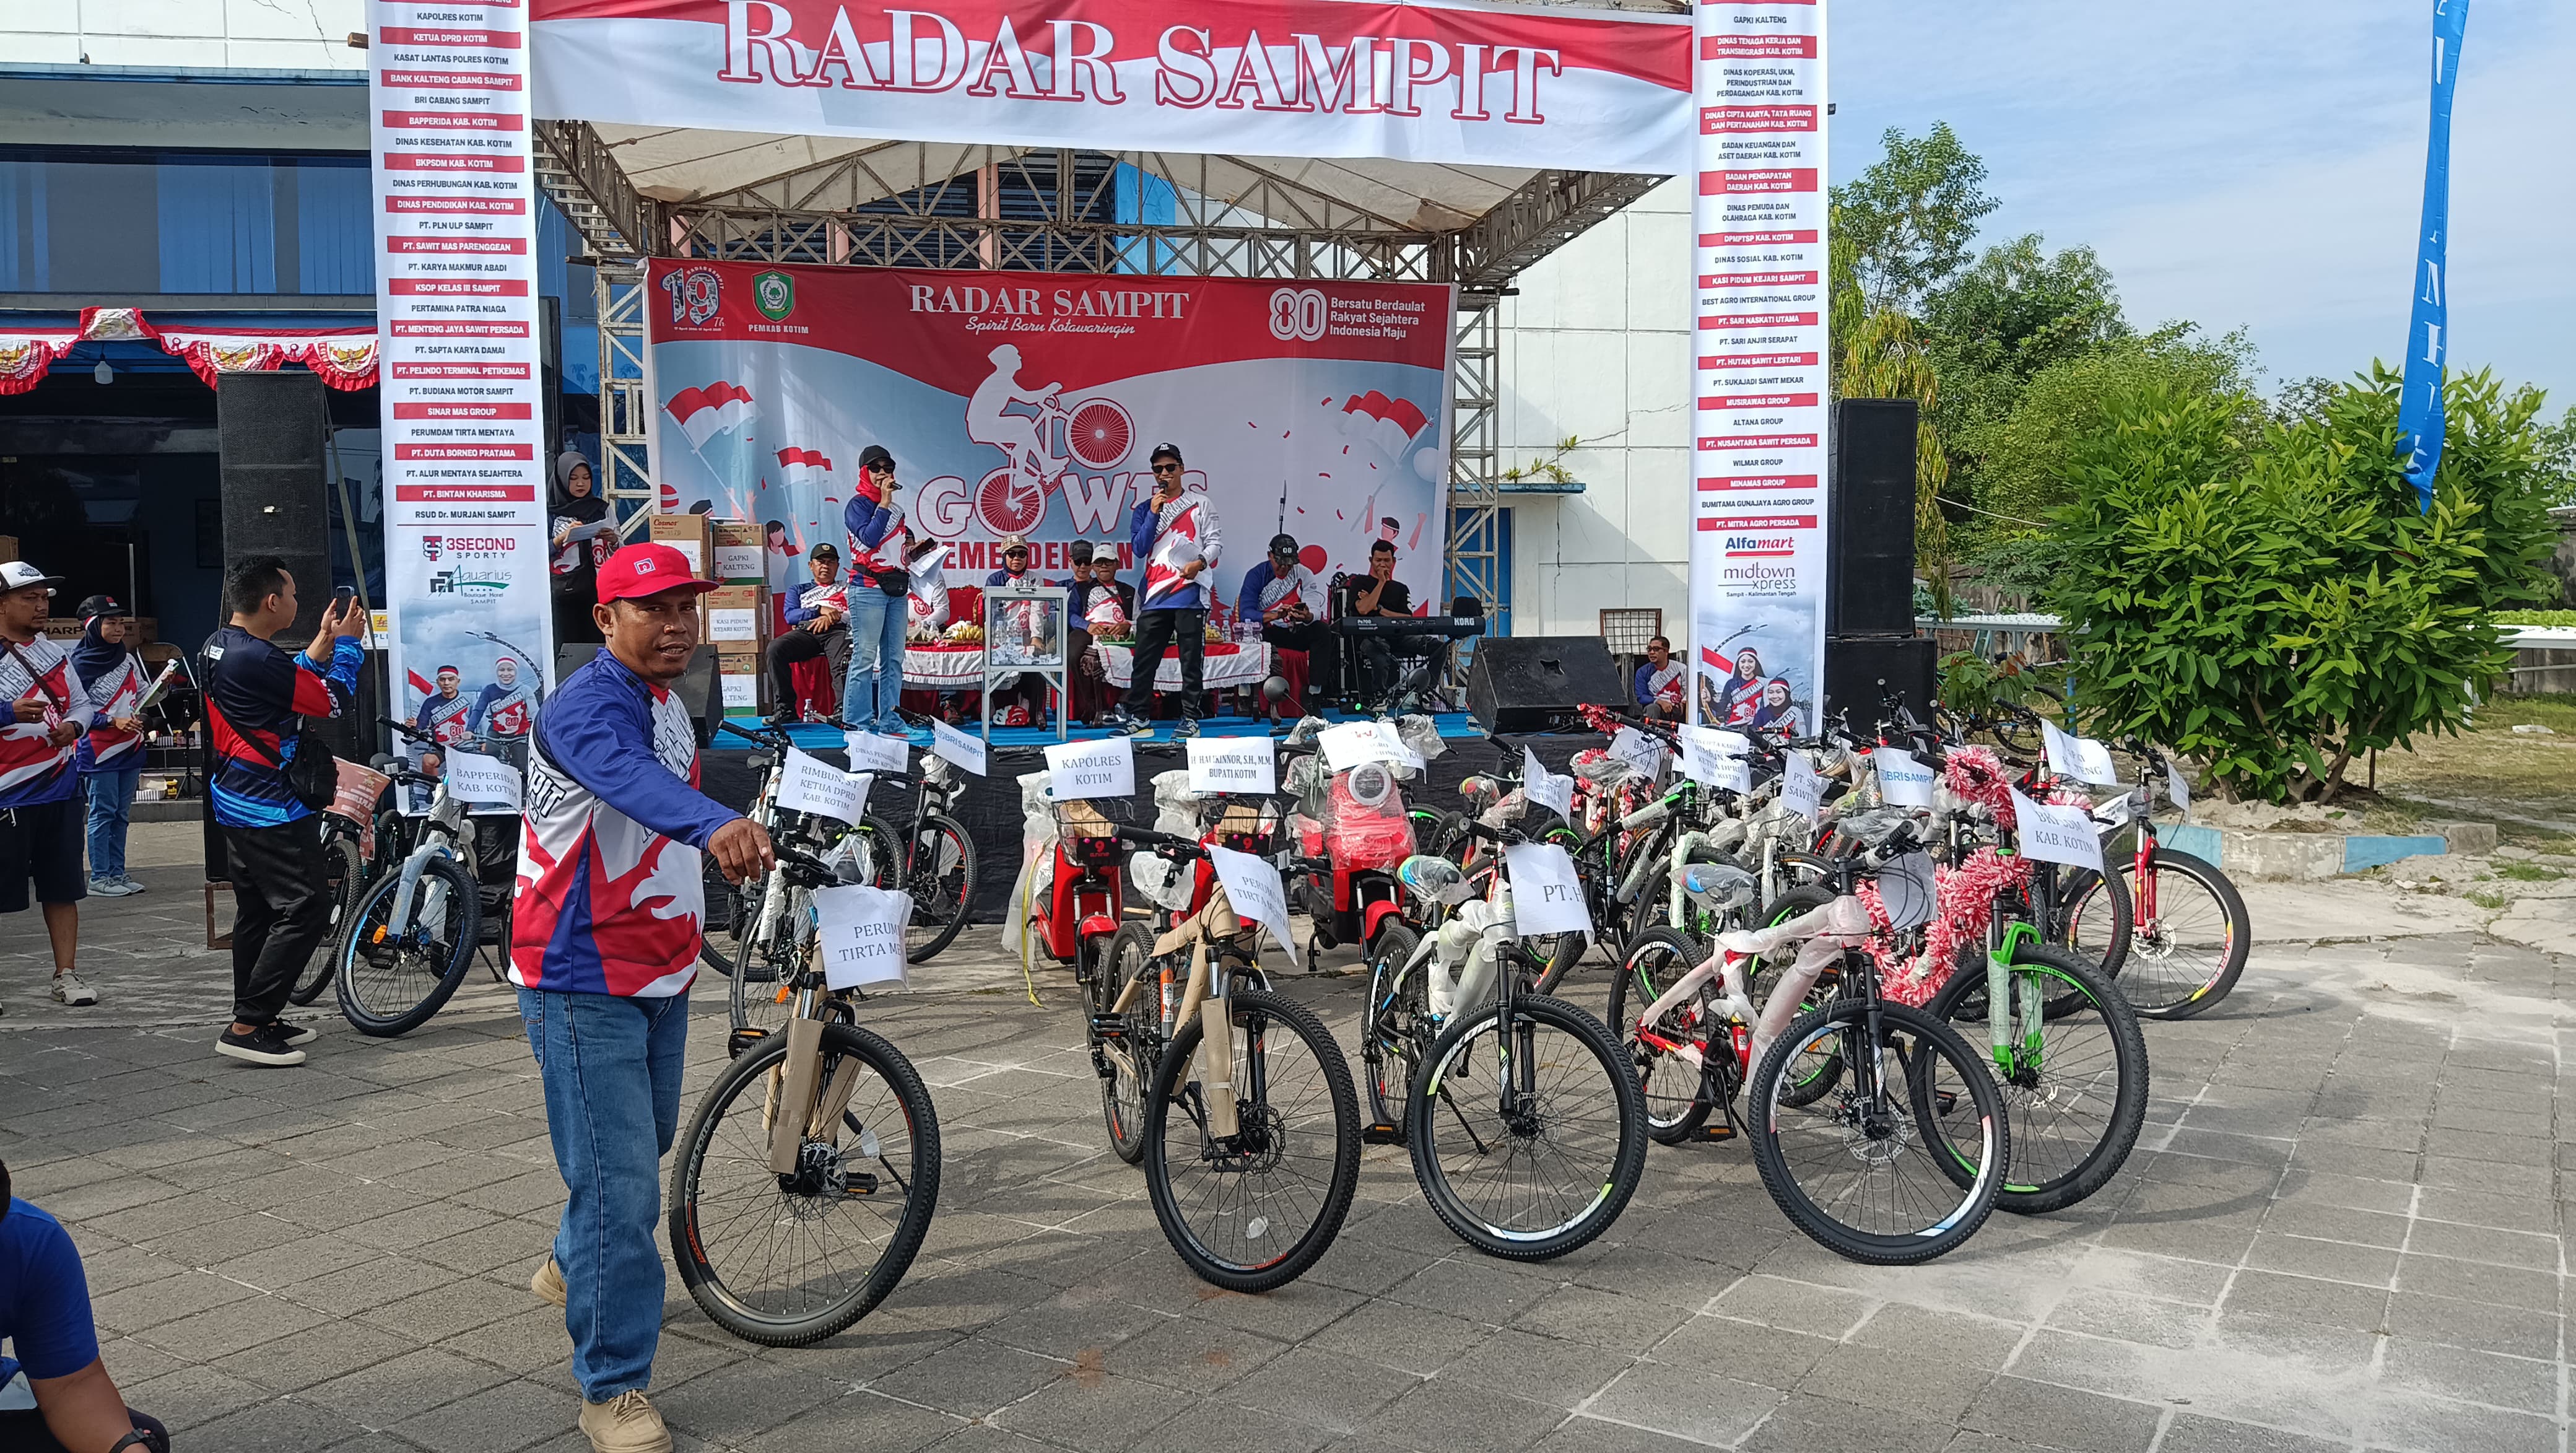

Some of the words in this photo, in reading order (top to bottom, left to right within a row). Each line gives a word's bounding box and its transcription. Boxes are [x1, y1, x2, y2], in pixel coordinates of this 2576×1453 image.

[716, 0, 1127, 104] RADAR
[1155, 25, 1563, 125] SAMPIT
[660, 267, 720, 325] 19
[909, 285, 1042, 315] RADAR
[1053, 289, 1190, 318] SAMPIT
[1331, 297, 1372, 310] Bersatu
[1375, 299, 1425, 312] Berdaulat
[1269, 287, 1327, 341] 80
[1330, 311, 1366, 325] Rakyat
[1368, 312, 1419, 326] Sejahtera
[749, 324, 780, 333] PEMKAB
[783, 325, 809, 334] KOTIM
[965, 316, 1008, 335] Spirit
[1010, 317, 1045, 331] Baru
[1048, 318, 1135, 338] Kotawaringin
[1330, 325, 1380, 337] Indonesia
[1383, 326, 1407, 340] Maju
[653, 518, 677, 526] Cosmos
[446, 538, 515, 551] 3SECOND
[1725, 537, 1795, 549] Alfamart
[1724, 562, 1795, 578] midtown
[1752, 579, 1796, 591] xpress
[1454, 617, 1474, 626] KORG
[1744, 708, 1756, 717] 80
[505, 717, 519, 726] 80
[450, 726, 463, 737] 80
[855, 747, 874, 756] DINAS
[1062, 755, 1121, 769] KAPOLRES
[1258, 755, 1273, 766] M.M.
[1698, 756, 1720, 770] KETUA
[456, 768, 516, 787] BAPPERIDA
[801, 766, 843, 785] RIMBUN,
[846, 779, 859, 790] S.T.
[1076, 772, 1112, 785] KOTIM
[1209, 768, 1234, 779] BUPATI
[1235, 769, 1257, 779] KOTIM
[1794, 772, 1805, 787] PT.
[457, 782, 483, 792] KAB.
[486, 784, 518, 800] KOTIM
[800, 779, 832, 793] KETUA
[835, 787, 856, 801] DPRD
[803, 793, 822, 803] KAB.
[824, 797, 850, 811] KOTIM
[2035, 831, 2061, 846] KAB.
[2065, 836, 2095, 855] KOTIM
[1235, 888, 1267, 907] TIRTA
[839, 942, 886, 961] TIRTA
